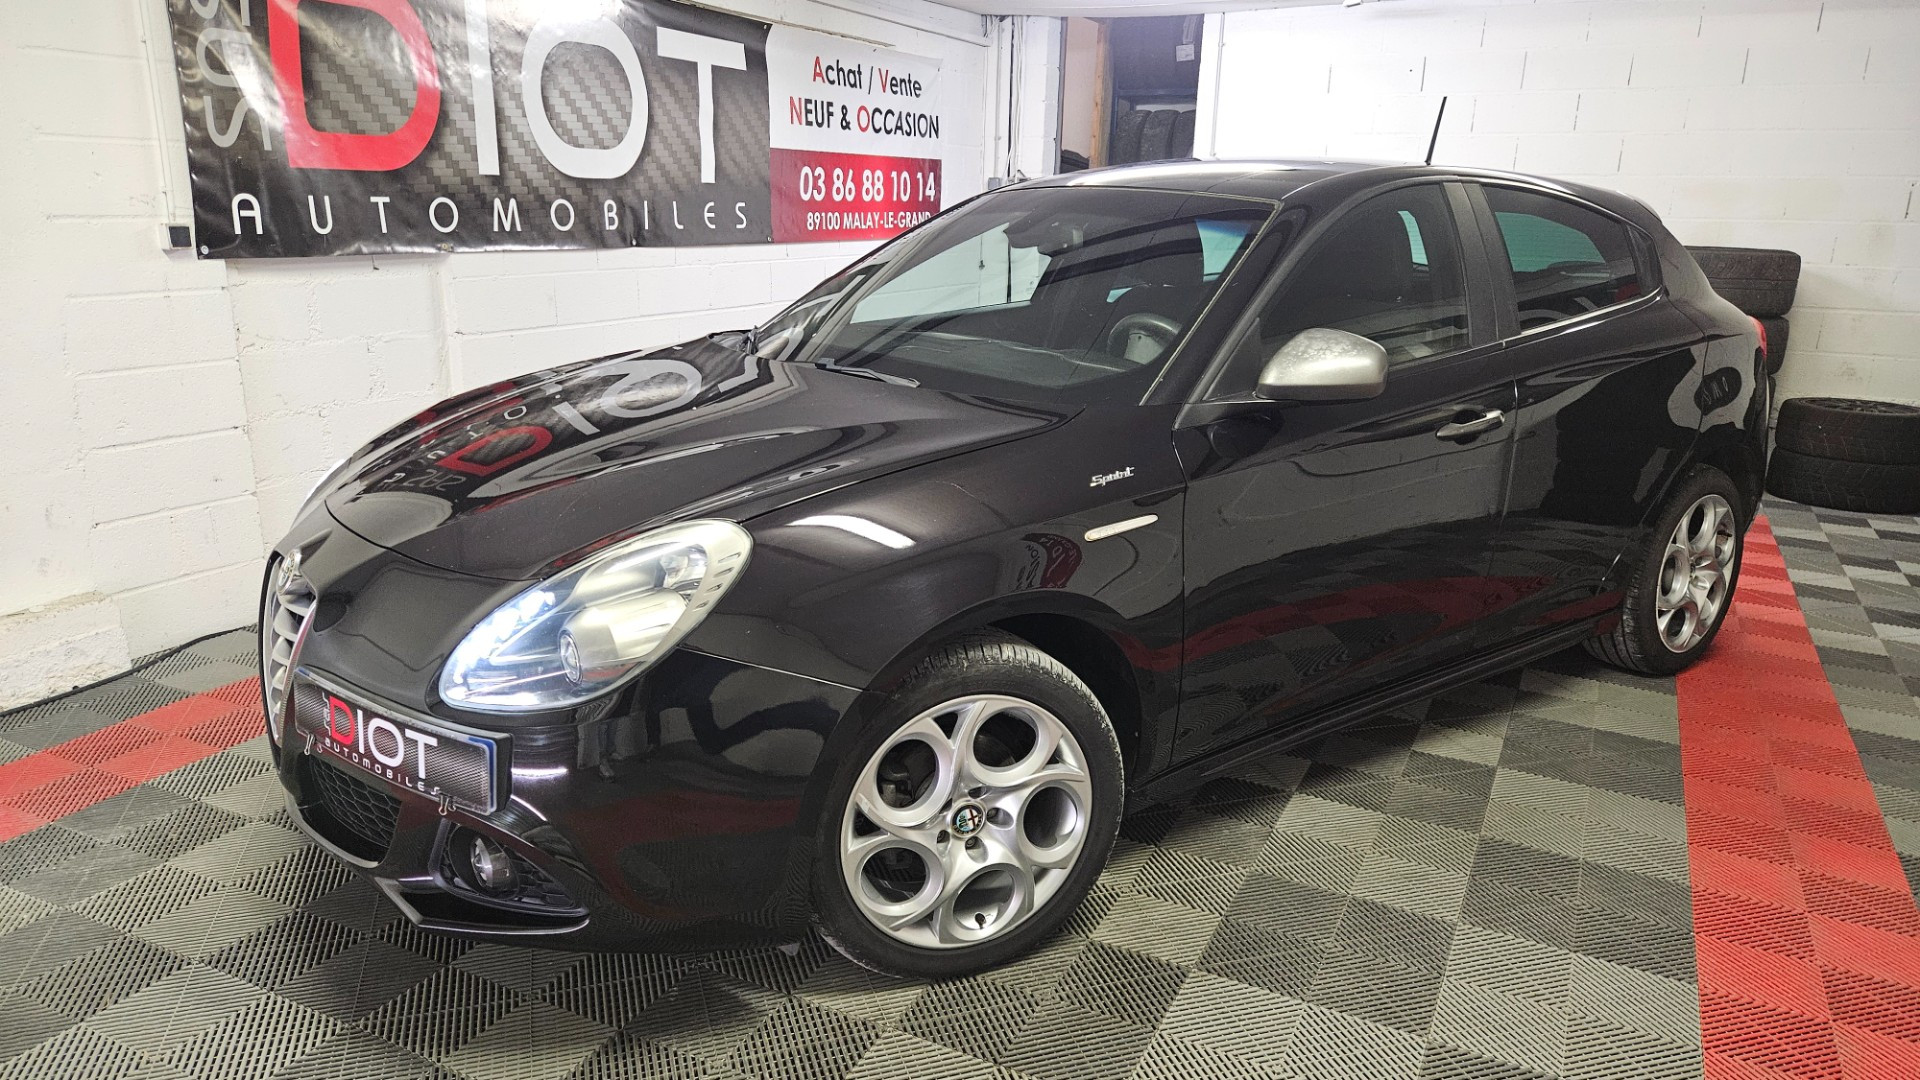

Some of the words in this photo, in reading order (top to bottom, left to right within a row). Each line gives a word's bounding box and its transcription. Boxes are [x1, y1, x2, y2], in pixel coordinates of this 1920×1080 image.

[267, 0, 747, 184] DIOT
[813, 56, 863, 89] Achat
[868, 66, 874, 95] /
[878, 68, 923, 98] Vente
[790, 96, 834, 128] NEUF
[840, 104, 852, 131] &
[857, 105, 940, 139] OCCASION
[799, 166, 826, 202] 03
[832, 167, 856, 202] 86
[861, 169, 885, 202] 88
[891, 170, 911, 202] 10
[917, 172, 936, 202] 14
[231, 192, 747, 235] AUTOMOBILES
[806, 211, 841, 230] 89100
[329, 695, 438, 780] DIOT
